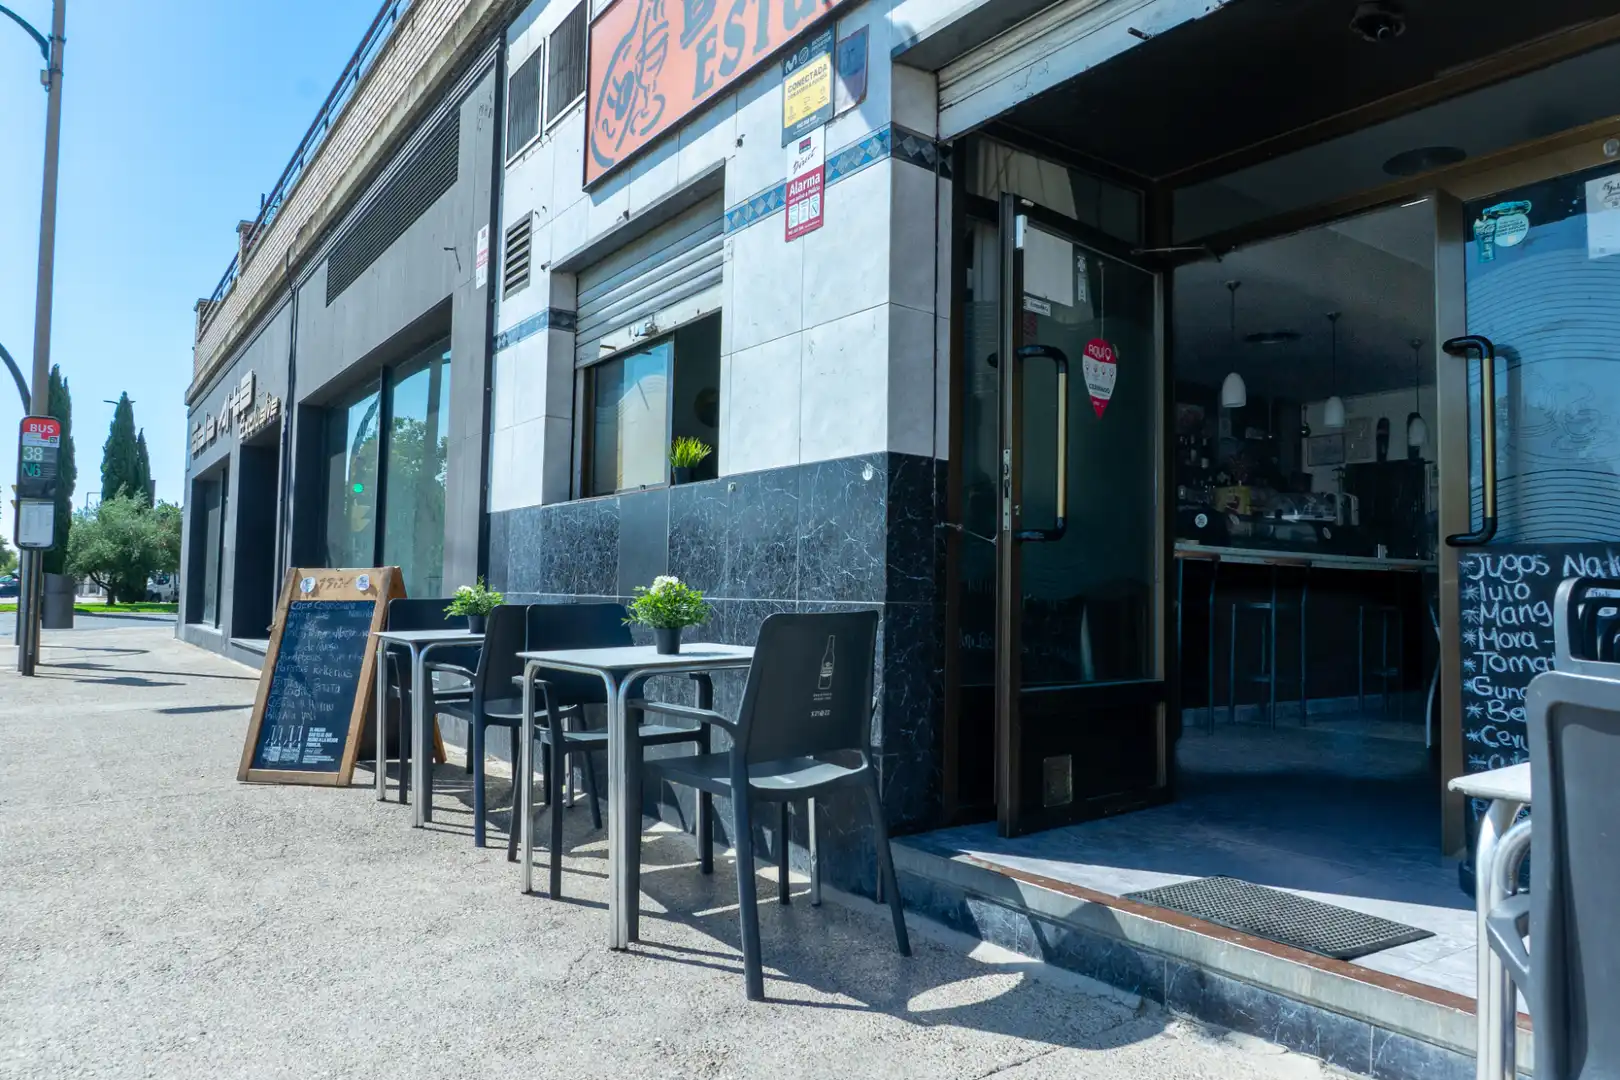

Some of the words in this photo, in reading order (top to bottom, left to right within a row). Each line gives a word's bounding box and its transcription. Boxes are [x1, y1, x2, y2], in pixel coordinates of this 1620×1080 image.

[787, 63, 828, 93] CONECTADA
[789, 172, 820, 197] Alarma
[29, 423, 54, 434] BUS
[23, 447, 43, 461] 38
[1467, 552, 1550, 584] Jugos
[1479, 600, 1553, 627] Mang
[1478, 627, 1539, 651] Mora
[1473, 651, 1556, 674] Tomat
